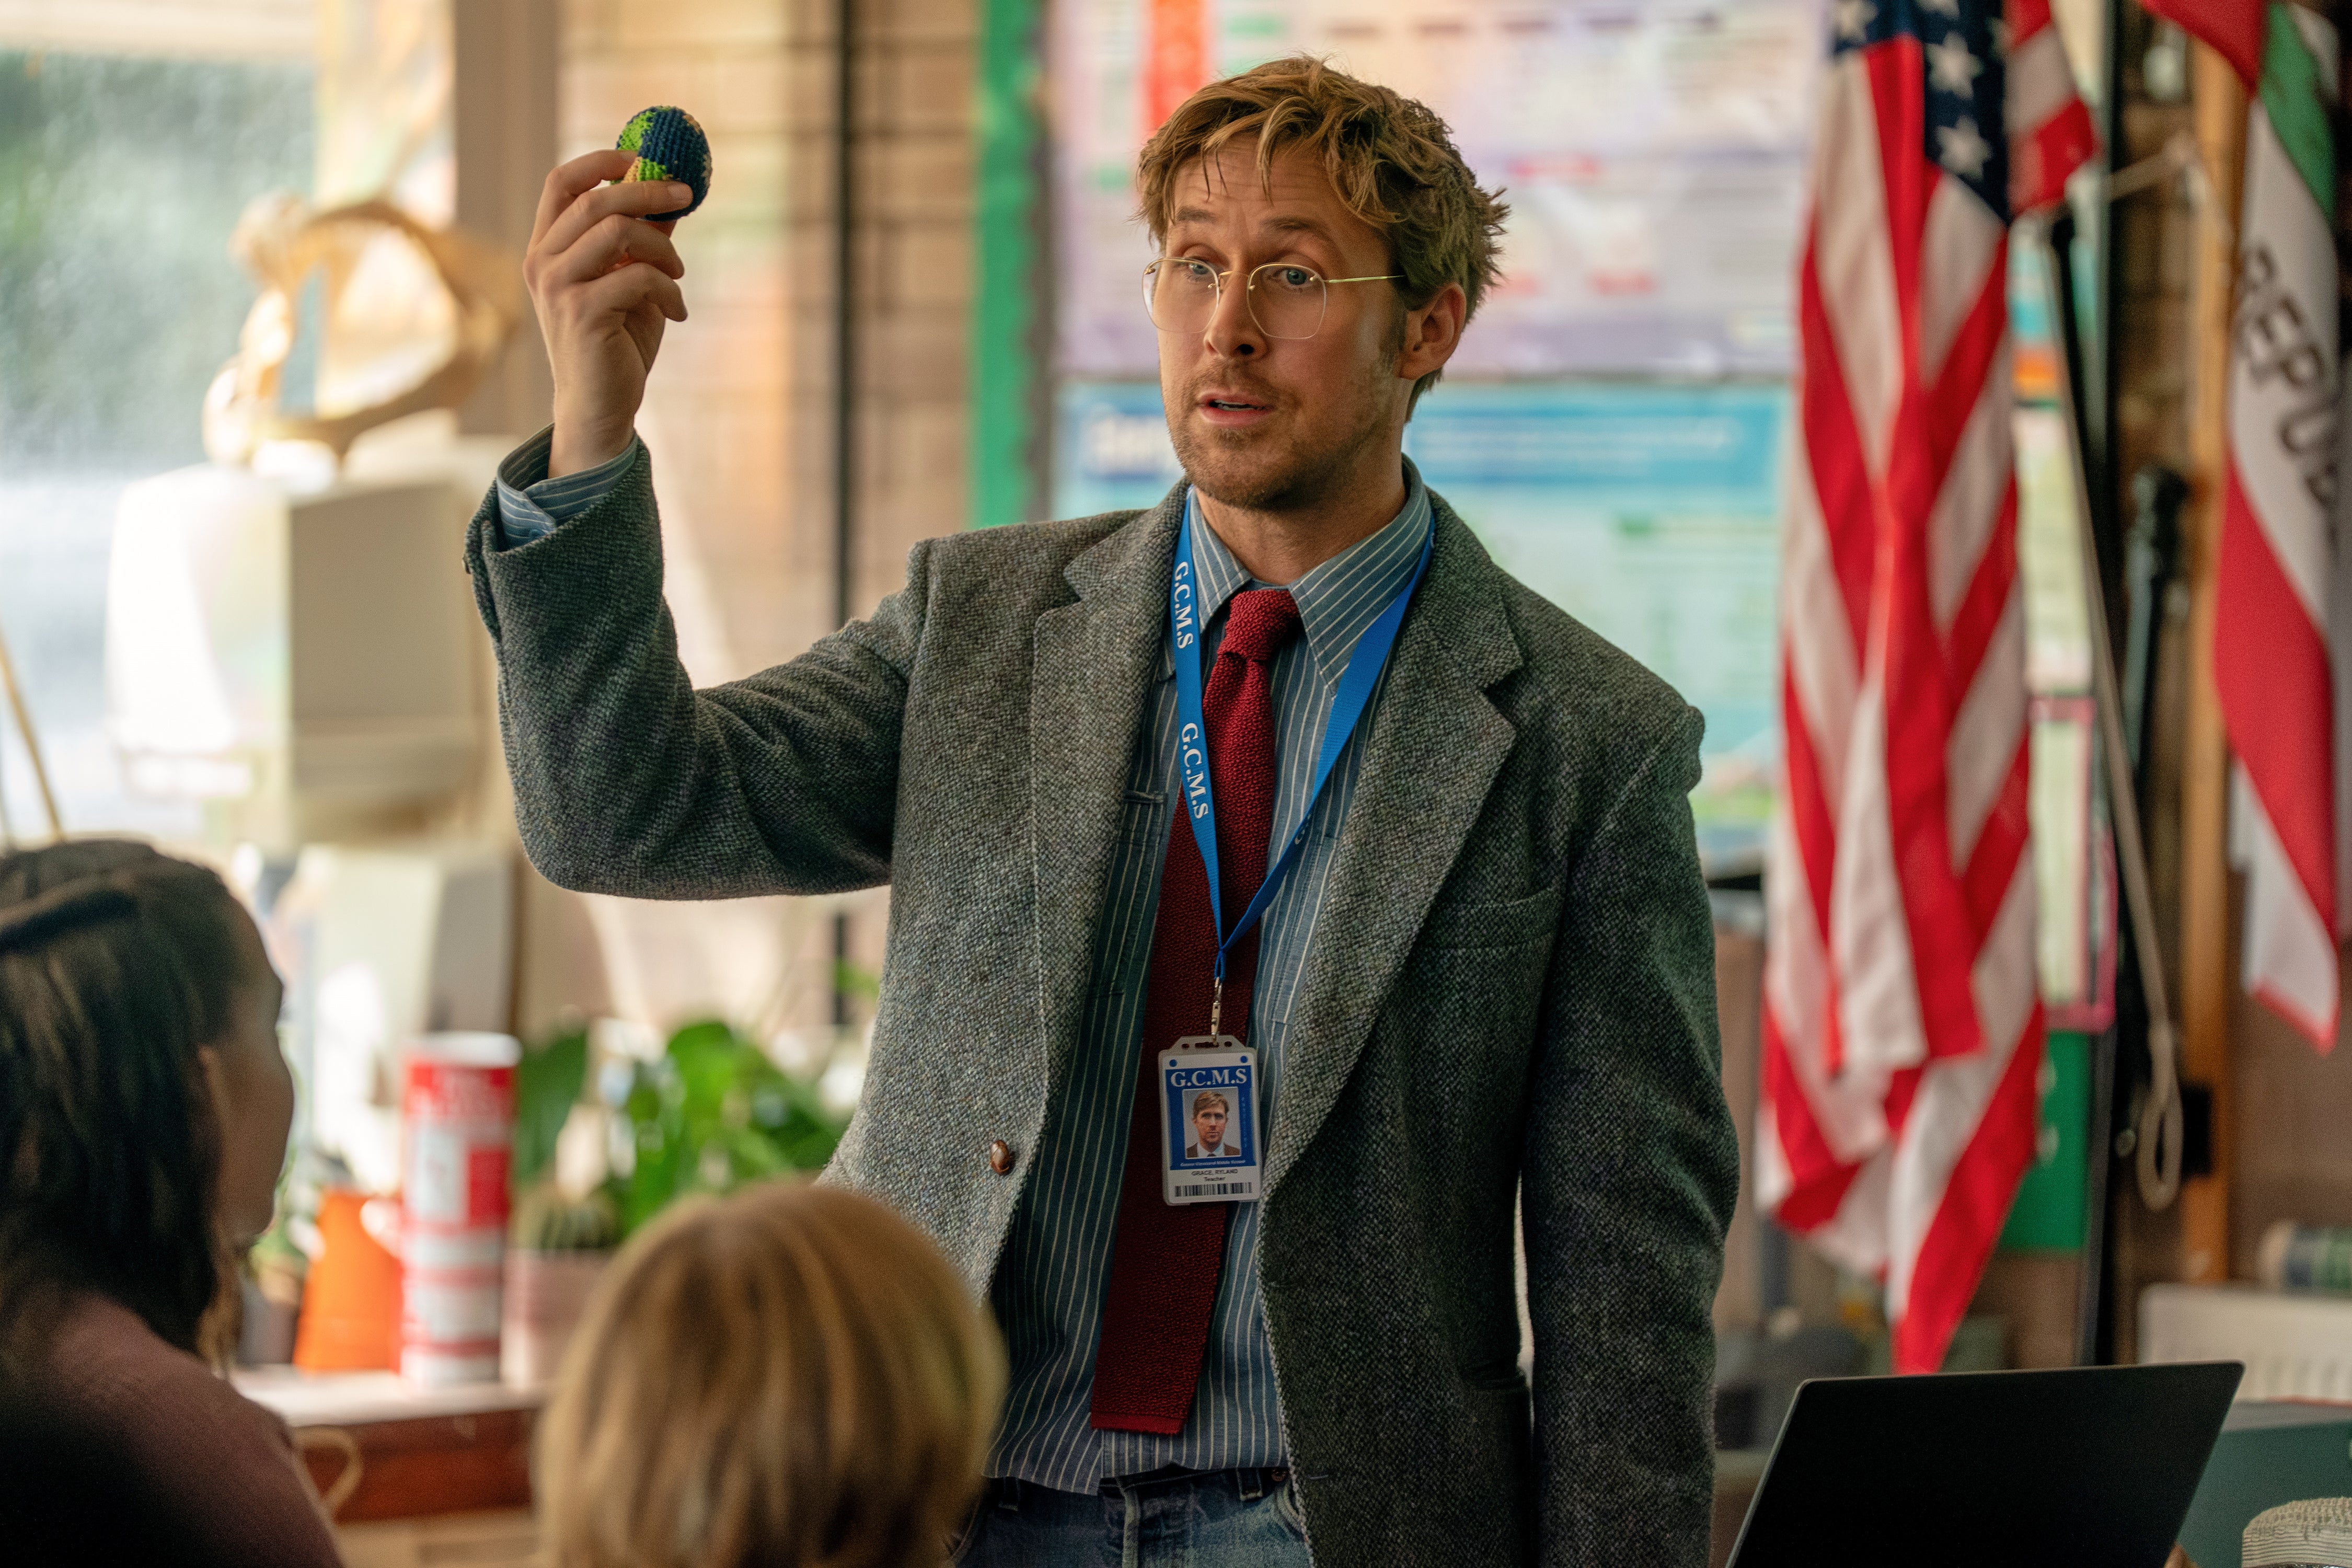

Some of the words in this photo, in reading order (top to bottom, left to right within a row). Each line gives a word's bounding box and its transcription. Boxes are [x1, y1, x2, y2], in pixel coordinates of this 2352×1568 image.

[1174, 561, 1194, 649] G.C.M.S
[1181, 722, 1209, 819] G.C.M.S
[1170, 1068, 1247, 1087] G.C.M.S
